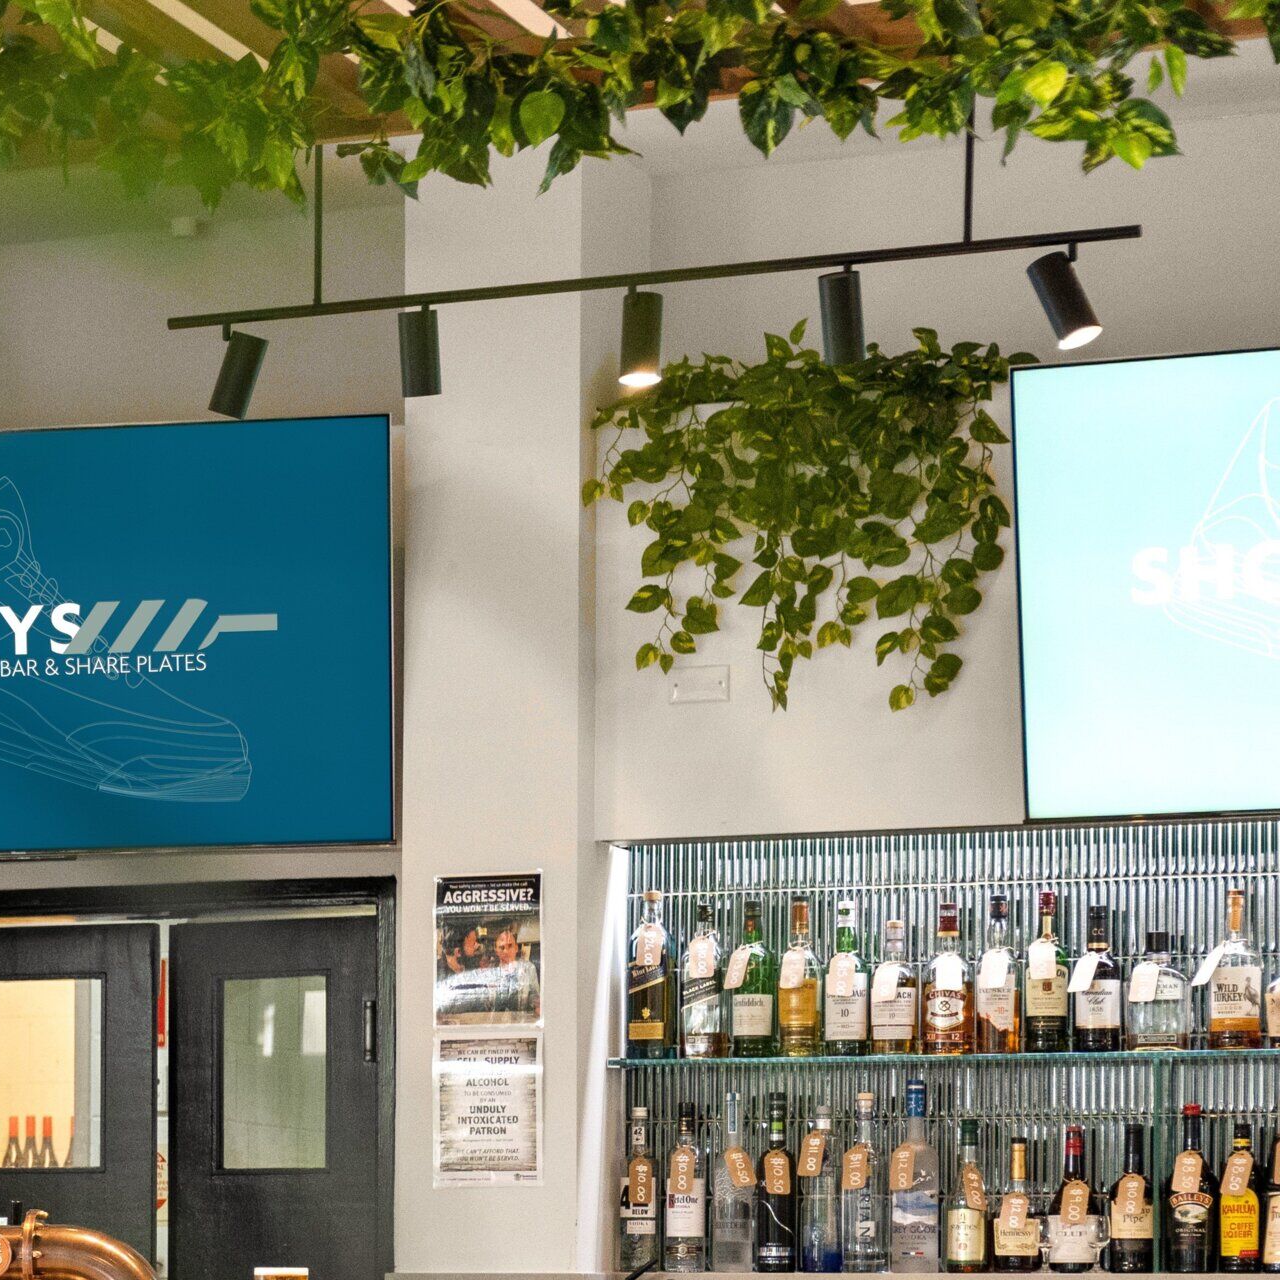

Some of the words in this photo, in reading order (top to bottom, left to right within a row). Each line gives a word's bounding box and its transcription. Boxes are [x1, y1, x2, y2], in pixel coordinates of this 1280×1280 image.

[0, 657, 40, 677] BAR
[45, 657, 60, 675] &
[65, 654, 131, 675] SHARE
[136, 651, 207, 673] PLATES
[443, 888, 534, 904] AGGRESSIVE?
[462, 905, 487, 913] WON'T
[489, 904, 500, 912] BE
[499, 903, 532, 911] SERVED.
[683, 985, 699, 995] BLACK
[699, 980, 716, 989] LABEL
[929, 990, 961, 999] CHIVAS
[1216, 983, 1238, 992] WILD
[1213, 991, 1243, 1002] TURKEY
[840, 1008, 849, 1017] 10
[951, 1033, 960, 1041] 12
[484, 1056, 520, 1065] SUPPLY
[465, 1077, 510, 1087] ALCOHOL
[469, 1105, 507, 1114] UNDULY
[457, 1115, 519, 1125] INTOXICATED
[469, 1126, 507, 1135] PATRON
[633, 1127, 643, 1136] 42
[806, 1138, 821, 1171] $11.00
[676, 1153, 690, 1190] $10.00
[730, 1152, 750, 1184] $10.50
[770, 1157, 786, 1193] $10.50
[849, 1153, 862, 1186] $11.00
[896, 1151, 910, 1188] $12.00
[1182, 1157, 1196, 1188] $8.50
[1229, 1157, 1247, 1191] $8.50
[635, 1164, 648, 1202] $10.00
[967, 1172, 982, 1205] $9.00
[1068, 1188, 1084, 1221] $9.00
[1126, 1181, 1139, 1213] $10.00
[1171, 1193, 1210, 1205] BAILEYS
[1009, 1198, 1024, 1229] $12.00
